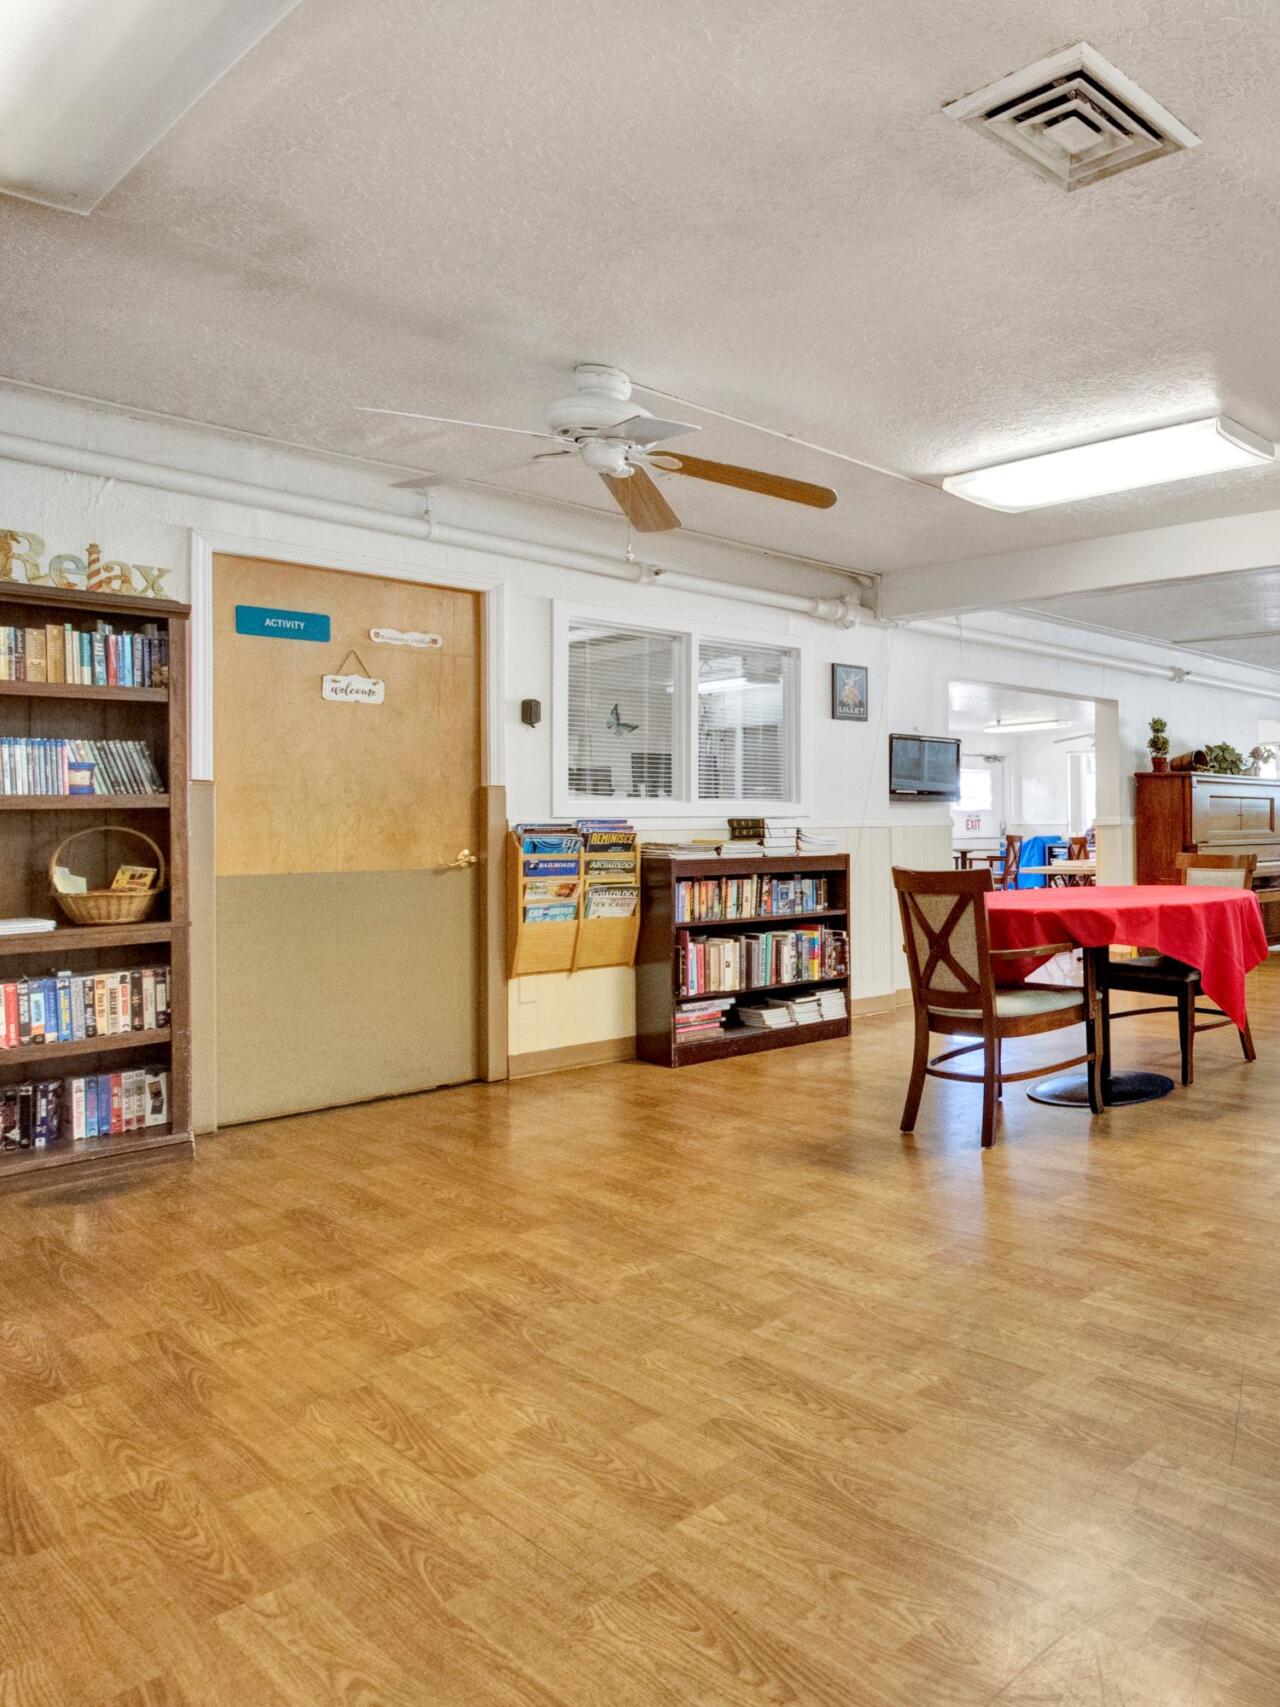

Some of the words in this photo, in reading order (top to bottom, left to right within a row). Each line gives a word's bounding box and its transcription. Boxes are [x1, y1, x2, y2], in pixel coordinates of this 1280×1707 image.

[0, 529, 172, 599] Relax
[264, 618, 305, 630] ACTIVITY
[330, 684, 377, 697] welcome
[966, 819, 981, 831] EXIT
[591, 833, 635, 845] REMINISCE
